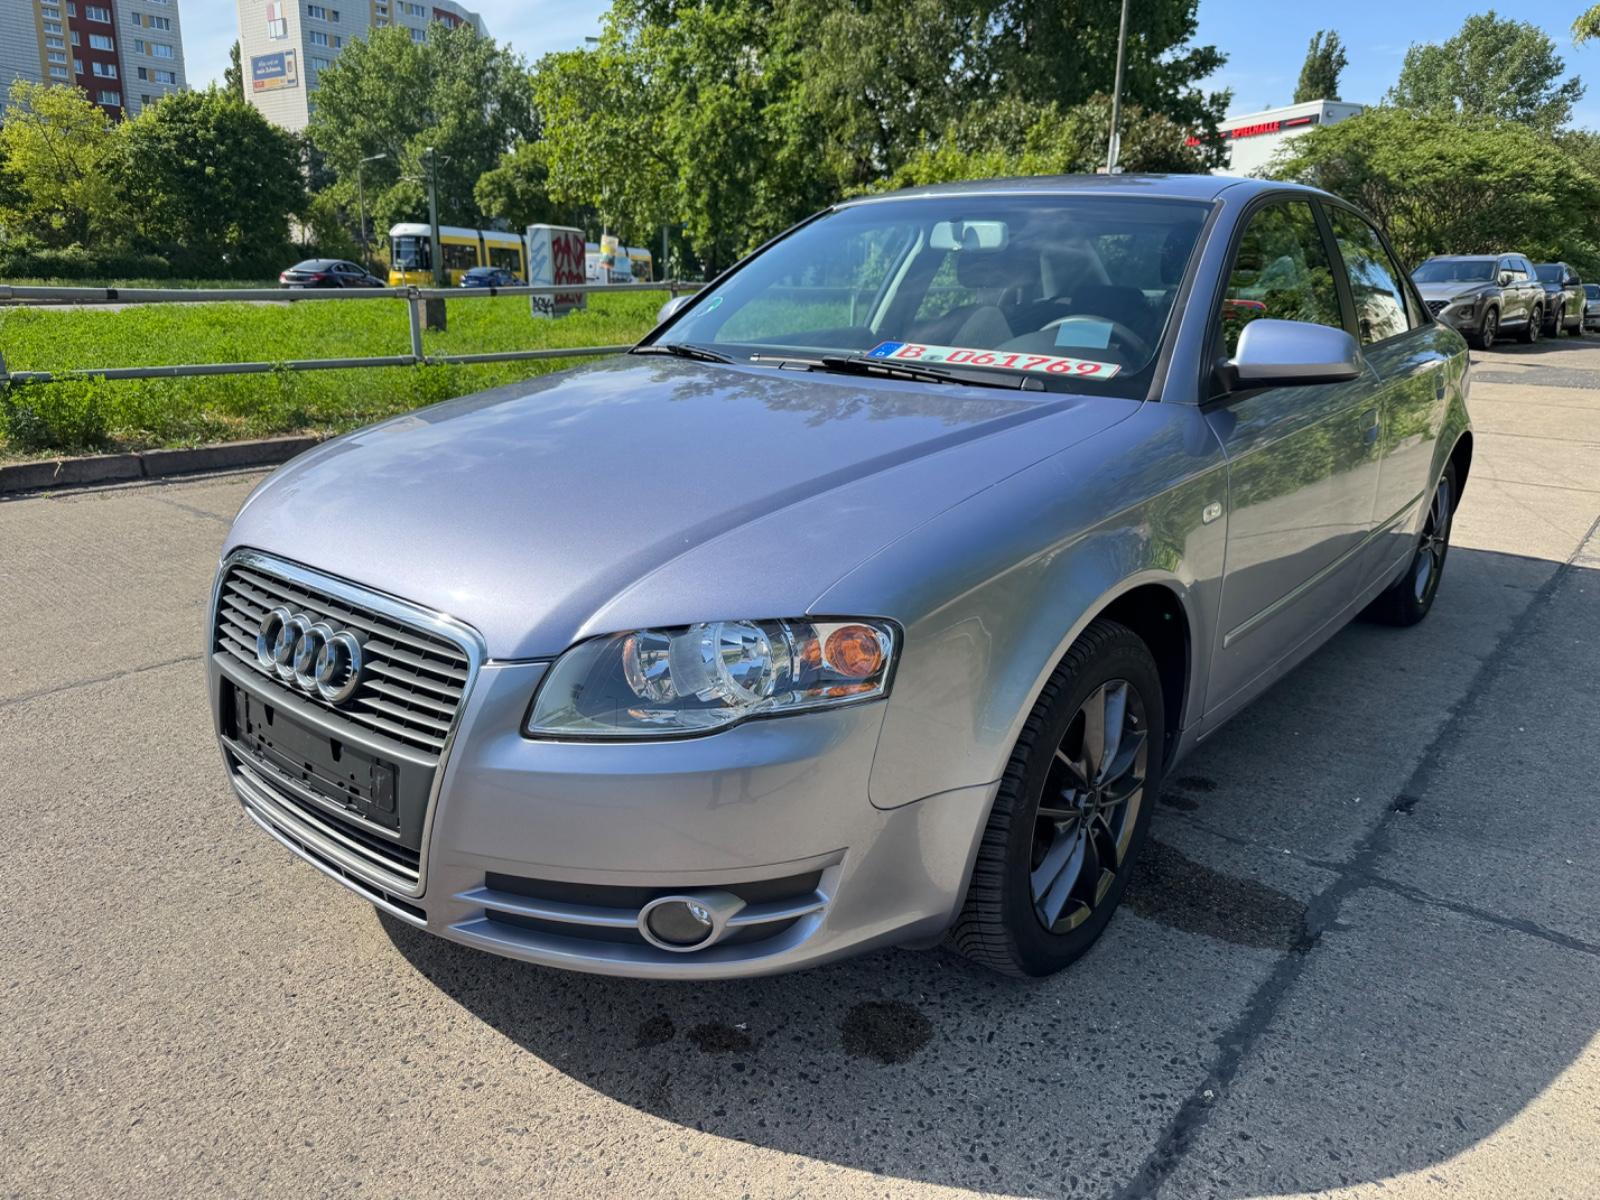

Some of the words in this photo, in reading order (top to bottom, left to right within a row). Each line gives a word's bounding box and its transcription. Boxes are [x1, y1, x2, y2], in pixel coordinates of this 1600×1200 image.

[1231, 121, 1280, 138] SPIELHALLE
[897, 345, 926, 358] B
[945, 349, 1102, 375] 061769
